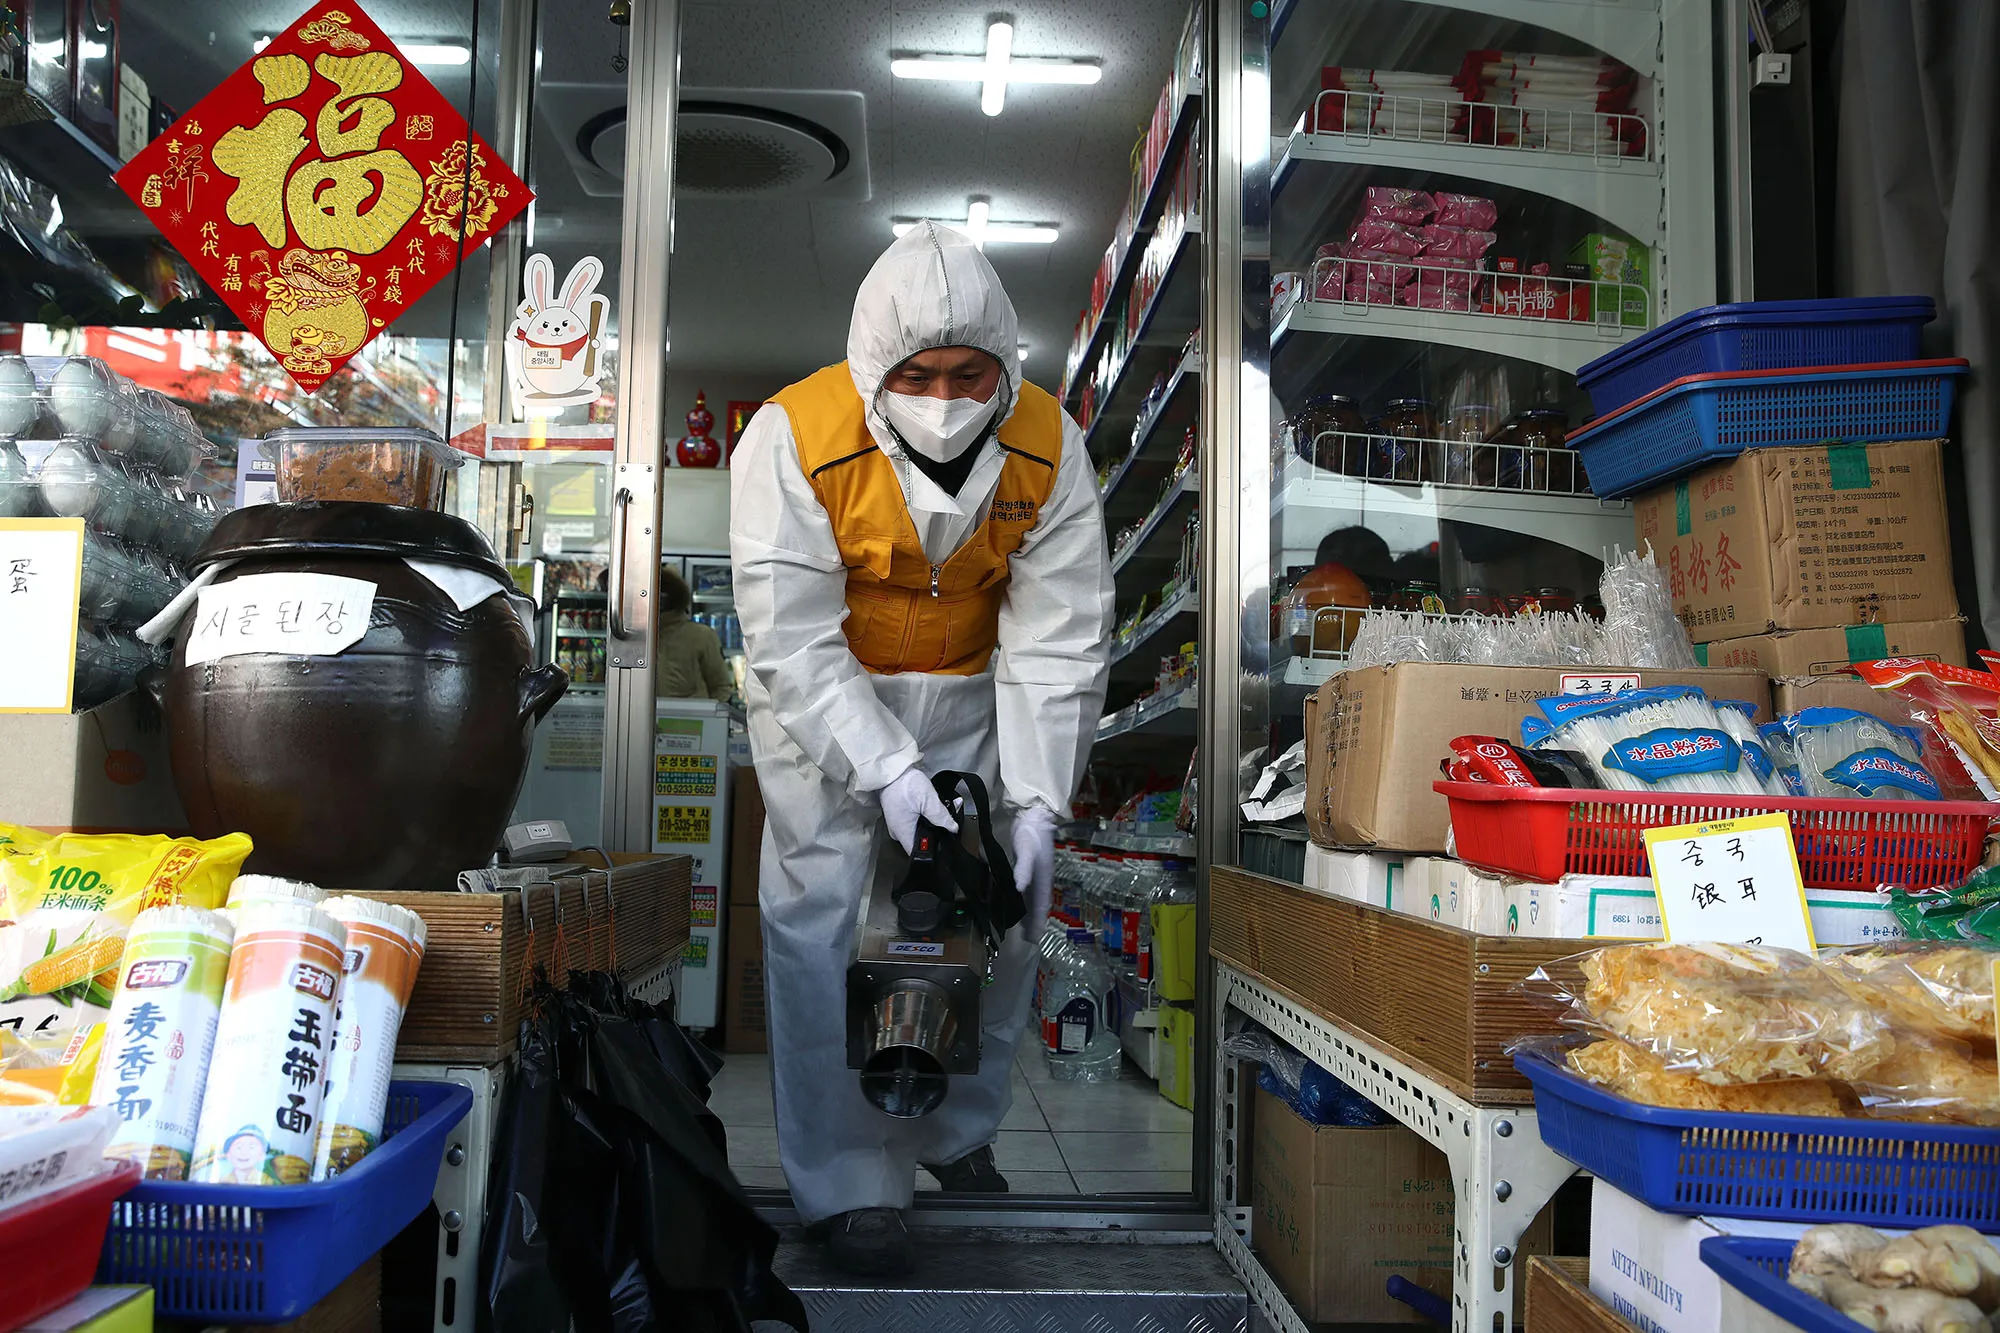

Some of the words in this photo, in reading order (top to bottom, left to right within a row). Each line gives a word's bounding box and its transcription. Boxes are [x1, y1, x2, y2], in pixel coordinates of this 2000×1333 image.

[184, 119, 203, 136] 福
[210, 50, 425, 255] 福
[492, 182, 510, 198] 福
[200, 220, 220, 259] 代代
[220, 252, 243, 292] 有福
[405, 237, 426, 275] 代代
[382, 264, 404, 305] 有錢
[1502, 289, 1555, 313] 片片肠
[530, 357, 555, 365] 중앙시장
[1668, 530, 1743, 600] 晶粉条
[658, 755, 700, 768] 우성냉동
[1626, 735, 1723, 763] 水晶粉条
[1849, 757, 1937, 790] 水晶粉条
[49, 864, 114, 896] 100%
[36, 891, 108, 912] 玉米面条
[130, 961, 185, 987] 古福
[296, 966, 335, 997] 古福
[108, 1001, 167, 1122] 麦香面
[276, 1007, 322, 1136] 玉带面
[1611, 1247, 1639, 1282] LELIN
[1638, 1266, 1683, 1314] KAIYUAN
[1612, 1291, 1639, 1326] CHINA
